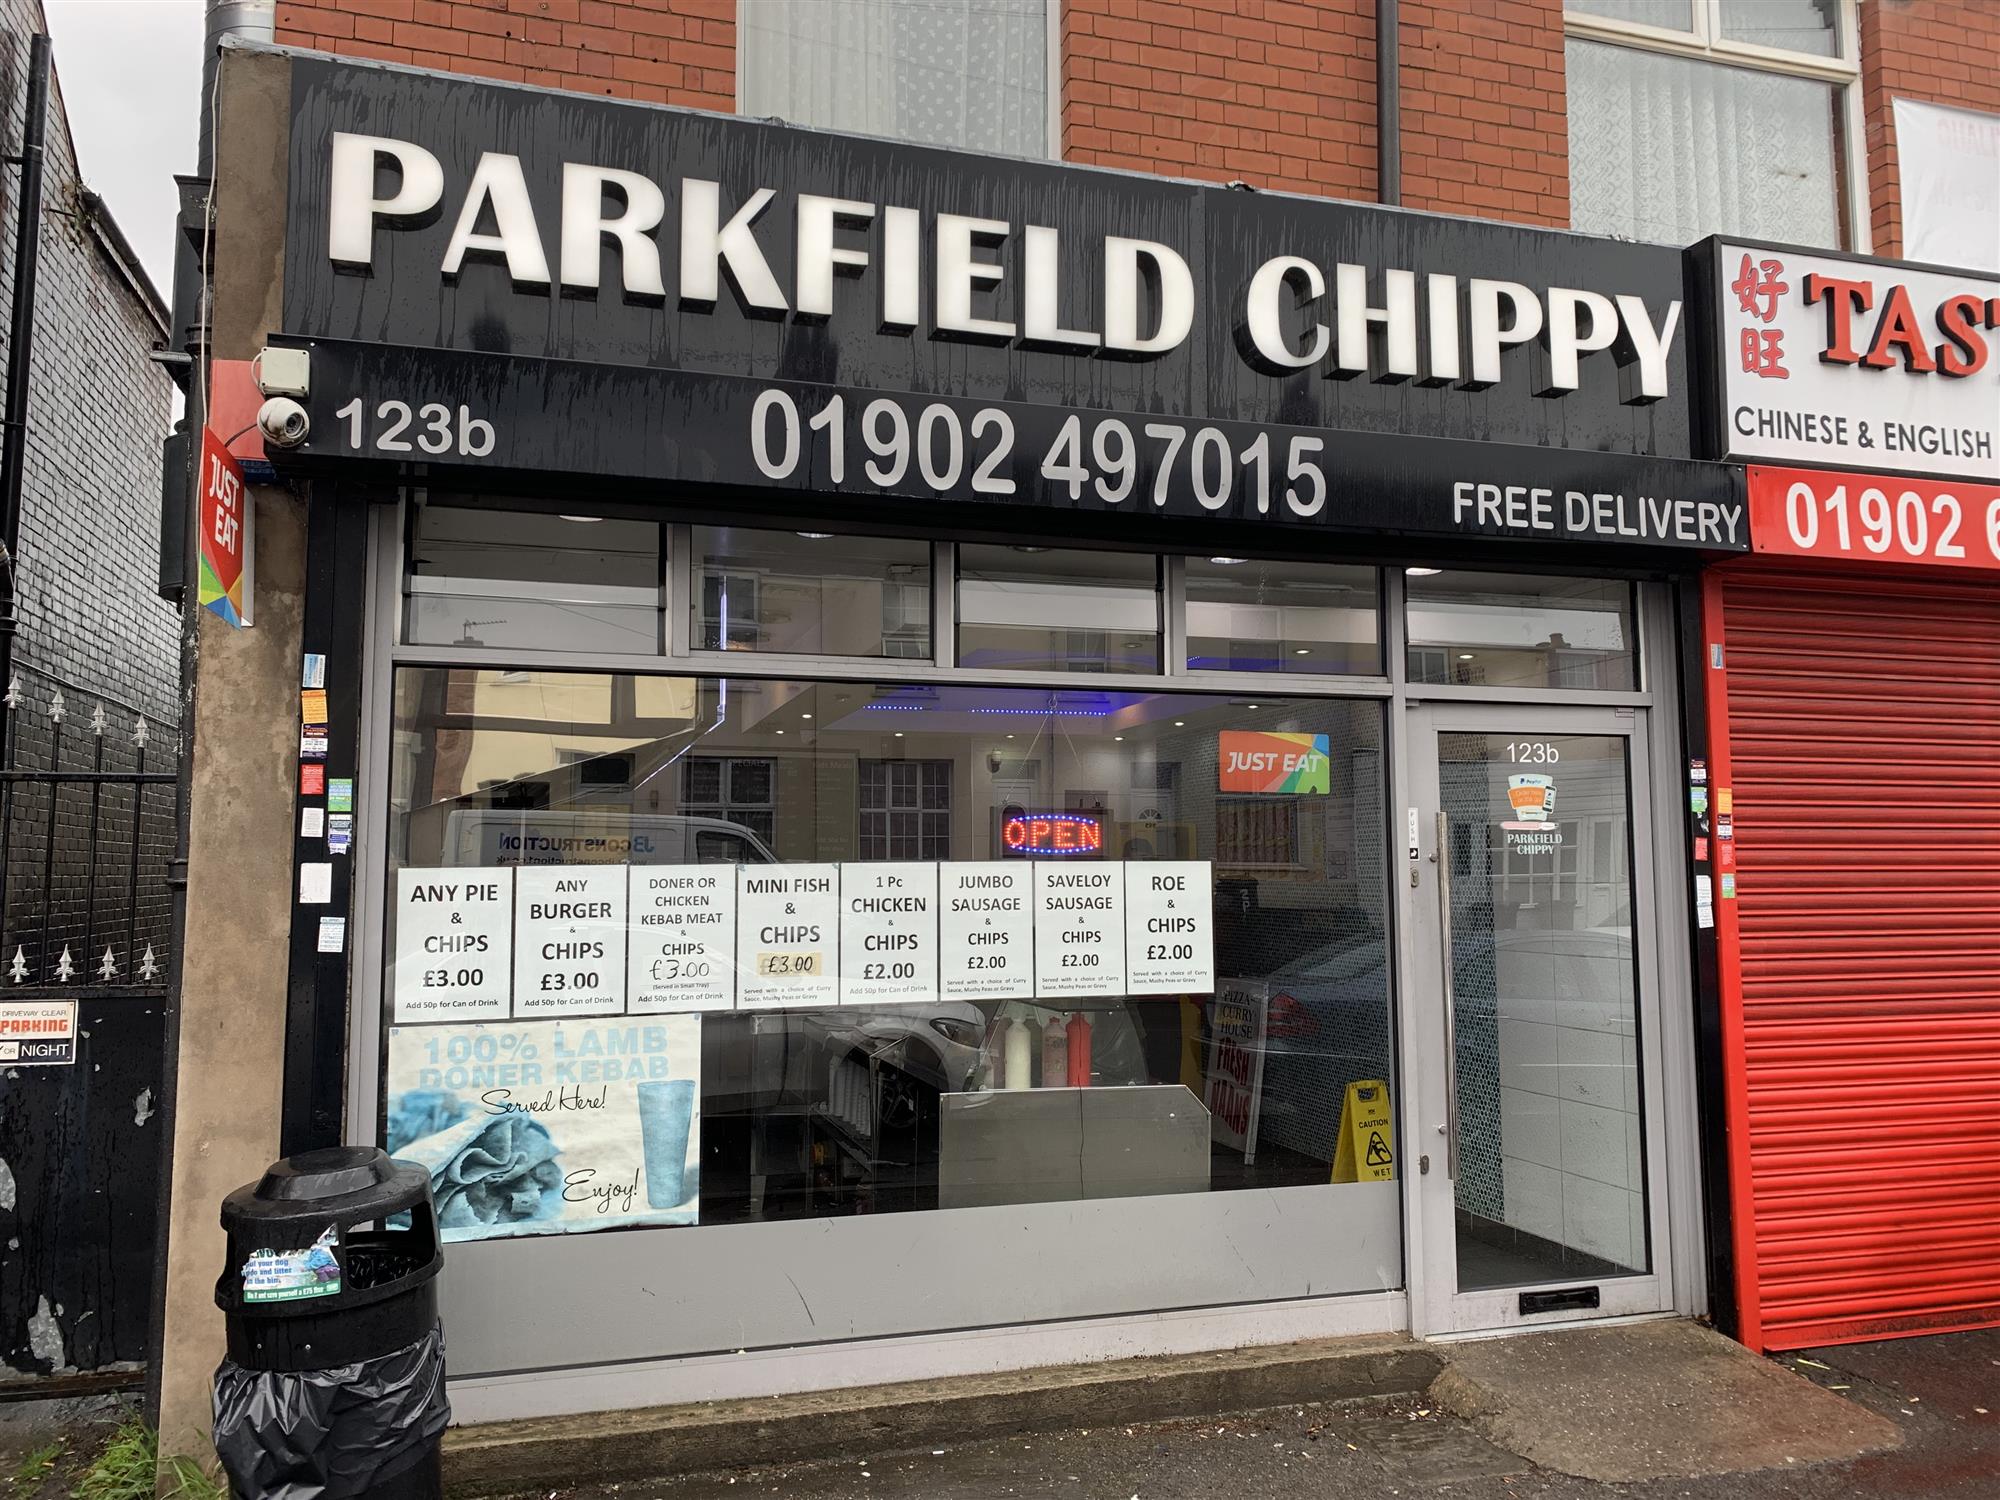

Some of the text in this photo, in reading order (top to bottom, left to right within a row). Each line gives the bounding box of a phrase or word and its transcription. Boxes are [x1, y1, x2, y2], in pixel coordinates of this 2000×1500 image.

[329, 131, 1683, 399] PARKFIELD CHIPPY
[1805, 272, 2000, 378] TAS
[1734, 405, 1992, 460] CHINESE & ENGLISH
[335, 388, 1327, 518] 123b 01902 497015
[208, 453, 240, 513] JUST
[1452, 480, 1743, 545] FREE DELIVERY
[1785, 481, 1966, 559] 01902
[215, 504, 239, 555] EAT
[1506, 742, 1560, 764] 123b
[1227, 751, 1322, 773] JUST EAT
[1004, 820, 1100, 848] OPEN
[1507, 833, 1563, 844] PARKFIELD
[1516, 844, 1555, 855] CHIPPY
[555, 880, 588, 892] ANY
[649, 877, 717, 889] DONER OR
[747, 878, 830, 894] MINI FISH
[876, 876, 903, 888] 1 Pc
[958, 875, 1013, 888] JUMBO
[1047, 874, 1111, 888] SAVELOY
[1152, 876, 1186, 891] ROE
[410, 884, 499, 902] ANY PIE
[655, 896, 710, 907] CHICKEN
[785, 902, 796, 915] &
[851, 897, 927, 913] CHICKEN
[951, 898, 1021, 912] SAUSAGE
[1046, 897, 1113, 910] SAUSAGE
[1167, 899, 1175, 909] &
[450, 912, 462, 924] &
[530, 902, 613, 920] BURGER
[641, 913, 723, 925] KEBAB MEAT
[985, 918, 991, 926] &
[1078, 916, 1085, 924] &
[1147, 918, 1196, 933] CHIPS
[760, 925, 821, 943] CHIPS
[968, 932, 1009, 945] CHIPS
[1062, 930, 1102, 943] CHIPS
[424, 934, 489, 953] CHIPS
[662, 943, 705, 956] CHIPS
[864, 934, 919, 951] CHIPS
[542, 942, 604, 960] CHIPS
[1147, 944, 1193, 960] £2.00
[768, 955, 813, 973] £3.00
[967, 955, 1006, 969] £2.00
[1061, 954, 1099, 967] £2.00
[649, 959, 710, 980] £3.00
[863, 962, 915, 980] £2.00
[422, 968, 484, 988] £3.00
[540, 972, 600, 991] £3.00
[654, 994, 668, 1003] 50p
[704, 992, 724, 1000] Drink
[864, 987, 877, 995] 50p
[1223, 990, 1251, 1006] PIZZA
[406, 998, 499, 1010] Add 50p for Can of Drink
[541, 999, 555, 1008] 50p
[557, 997, 567, 1005] for
[569, 997, 583, 1005] Can
[585, 996, 593, 1004] of
[594, 996, 615, 1004] Drink
[1222, 1005, 1253, 1023] CURRY
[0, 1019, 68, 1032] PARKING
[1220, 1021, 1253, 1039] HOUSE
[21, 1044, 69, 1057] NIGHT
[423, 1026, 669, 1065] 100% LAMB
[1216, 1036, 1250, 1087] FRESH
[419, 1056, 670, 1090] DONER KEBAB
[481, 1085, 607, 1116] Served Here!
[1210, 1079, 1251, 1137] NAANS
[1358, 1119, 1389, 1129] CAUTION
[1373, 1168, 1391, 1177] WET
[562, 1168, 640, 1214] Enjoy!
